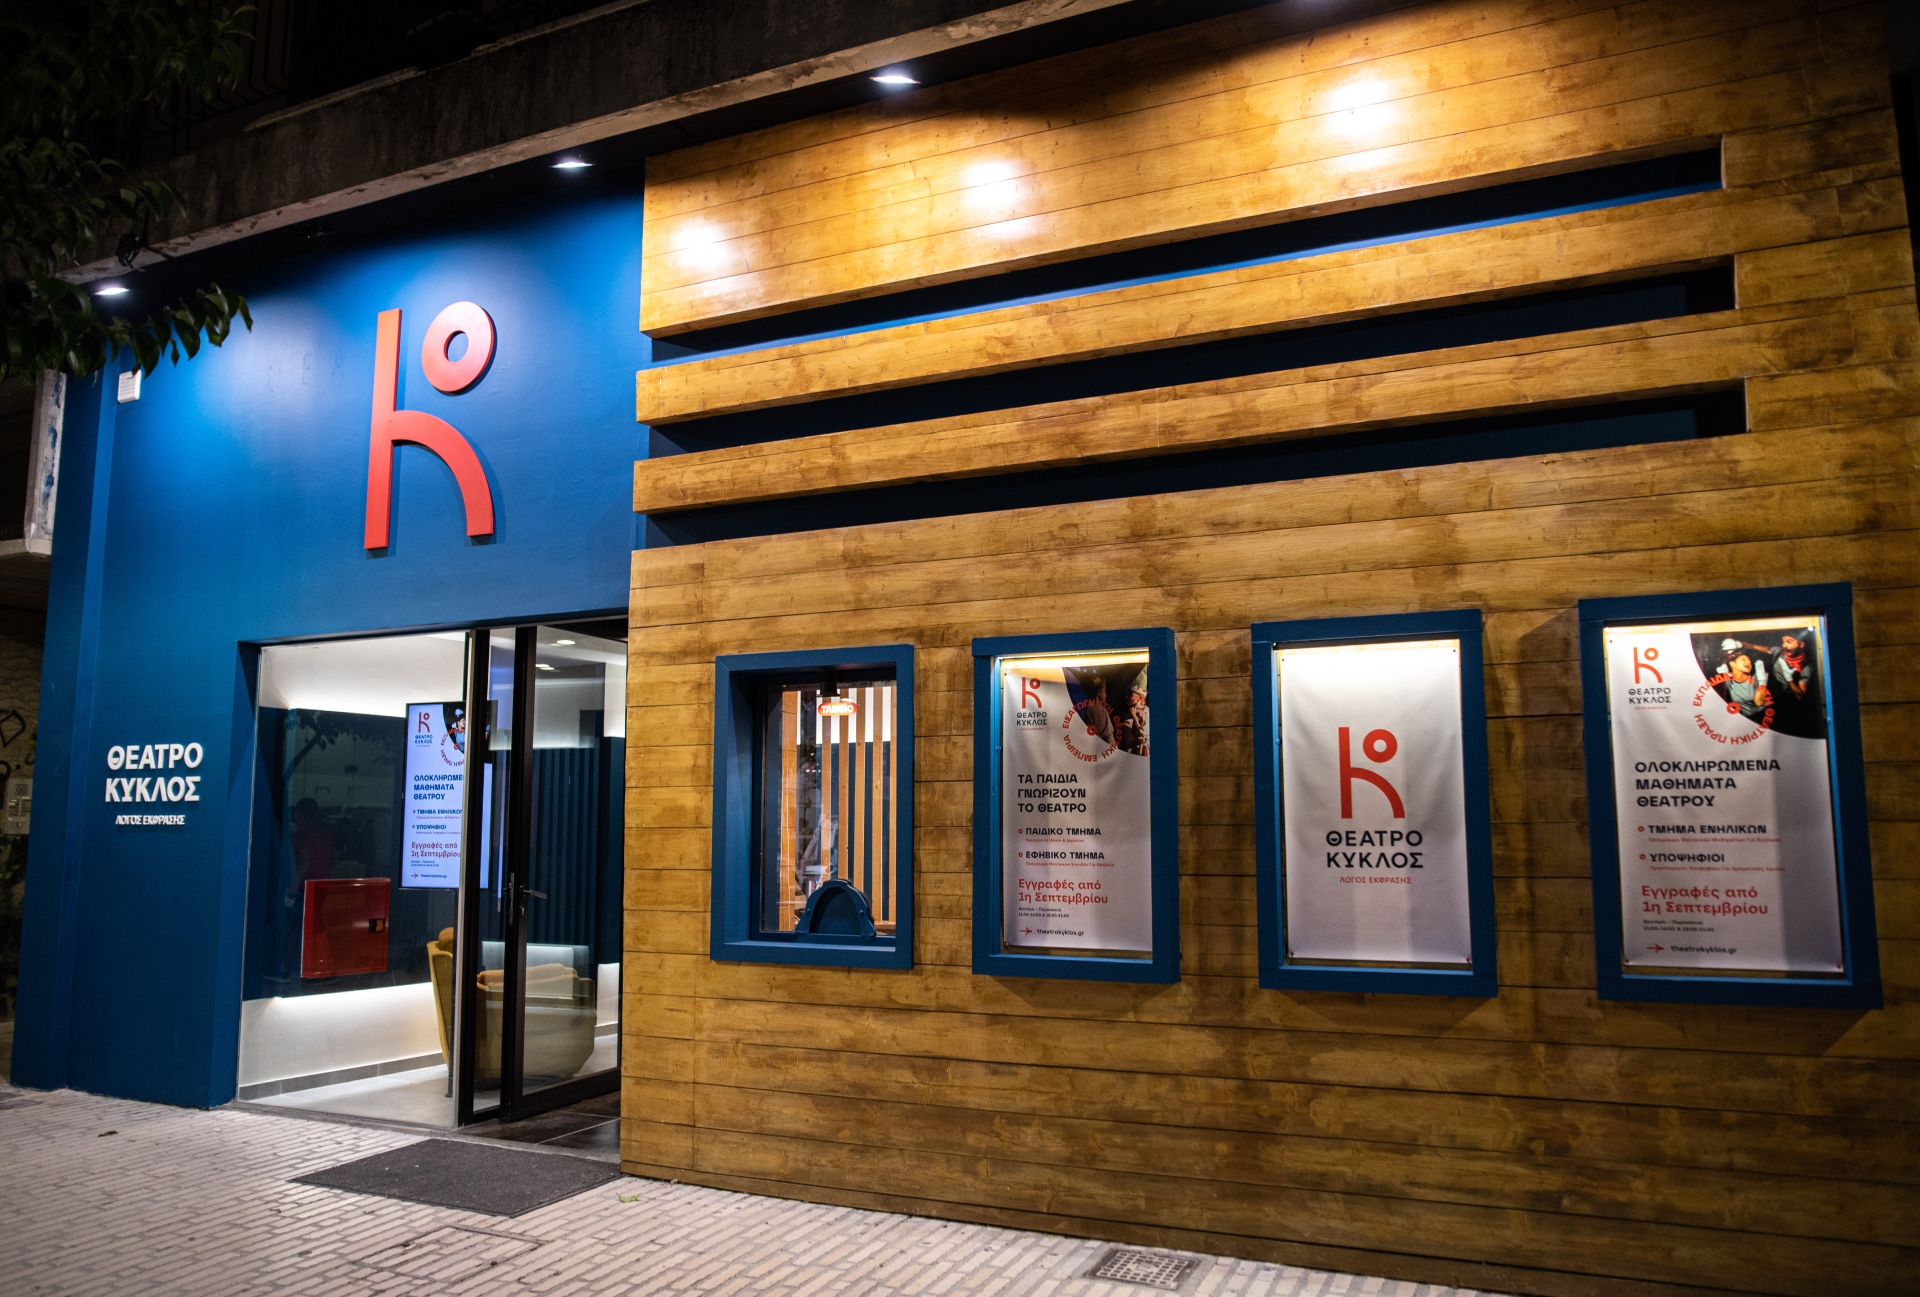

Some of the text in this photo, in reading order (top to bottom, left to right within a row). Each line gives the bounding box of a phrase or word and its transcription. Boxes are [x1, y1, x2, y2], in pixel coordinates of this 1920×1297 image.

[1628, 687, 1671, 696] ΘΕΑΤΡΟ
[1628, 696, 1672, 704] ΚΥΚΛΟΣ
[1063, 699, 1095, 729] ΕΙΣΑΓΩΓΗ
[1694, 714, 1727, 744] ΠΡΑΞΗ
[1731, 708, 1775, 745] ΘΕΑΤΡΙΚΗ
[1101, 716, 1123, 759] ΘΕΑΤΡΙΚΗ
[1063, 734, 1097, 762] ΕΜΠΕΙΡΙΑ
[107, 742, 204, 771] ΘΕΑΤΡΟ
[1635, 759, 1781, 773] ΟΛΟΚΛΗΡΩΜΕΝΑ
[414, 774, 464, 782] ΟΛΟΚΛΗΡΩΜΕ
[1018, 774, 1078, 784] ΤΑ ΠΑΙΔΙΑ
[1636, 777, 1737, 790] ΜΑΘΗΜΑΤΑ
[105, 776, 201, 803] ΚΥΚΛΟΣ
[1018, 788, 1086, 798] ΓΝΩΡΙΖΟΥΝ
[1637, 795, 1715, 807] ΘΕΑΤΡΟΥ
[1018, 803, 1086, 813] ΤΟ ΘΕΑΤΡΟ
[115, 815, 185, 825] ΛΟΓΟΣ ΕΚΦΡΑΣΗΣ
[1066, 828, 1101, 836] ΤΜΗΜΑ
[1648, 825, 1767, 834] ΤΜΗΜΑ ΕΝΗΛΙΚΩΝ
[1326, 830, 1423, 847] ΘΕΑΤΡΟ
[411, 841, 443, 850] Εγγραφές
[411, 850, 419, 858] 1η
[1025, 851, 1105, 860] ΕΦΗΒΙΚΟ ΤΜΗΜΑ
[1649, 853, 1725, 862] ΥΠΟΨΗΦΙΟΙ
[1326, 852, 1424, 868] ΚΥΚΛΟΣ
[1018, 878, 1101, 891] Εγγραφές από
[1340, 876, 1412, 884] ΛΟΓΟΣ ΕΚΦΡΑΣΗΣ
[1642, 885, 1758, 899] Εγγραφές από
[1018, 892, 1108, 905] 1η Σεπτεμβρίου
[1642, 901, 1768, 916] 1η Σεπτεμβρίου
[1037, 928, 1084, 937] theatrokyklos.gr
[1670, 945, 1737, 954] theatrokyklos.gr
